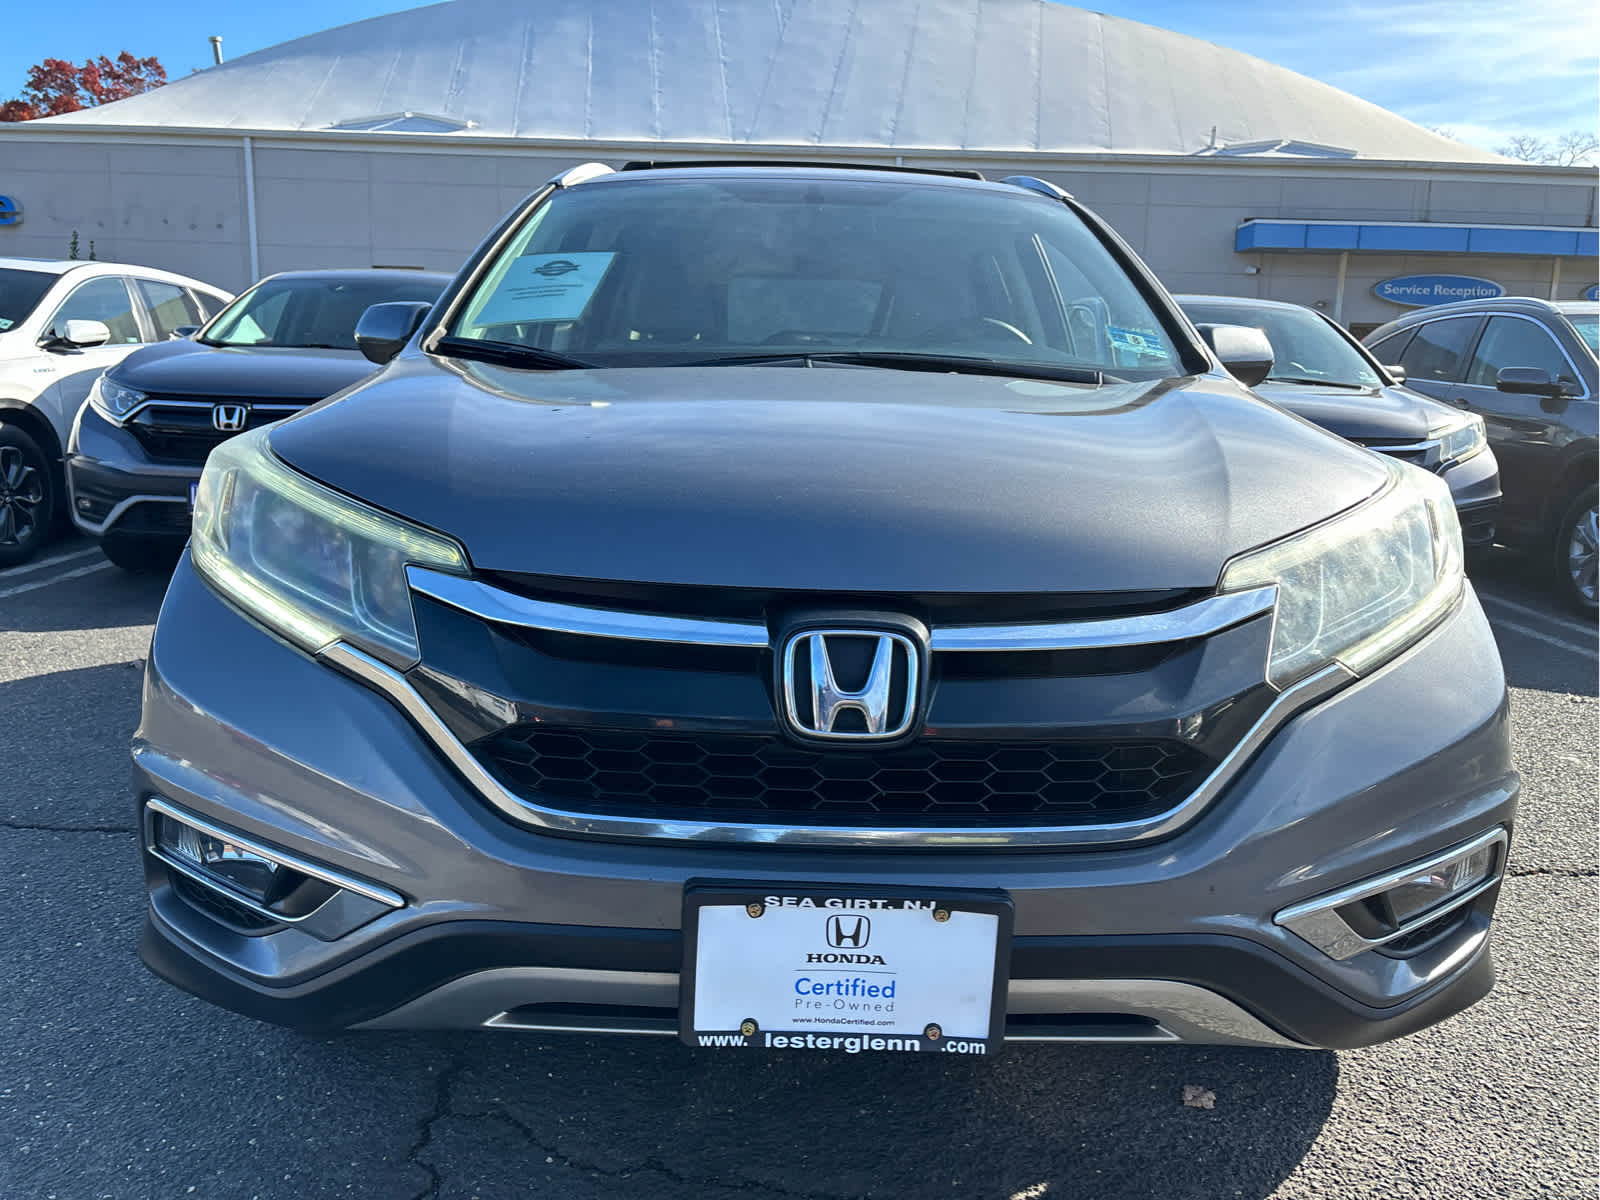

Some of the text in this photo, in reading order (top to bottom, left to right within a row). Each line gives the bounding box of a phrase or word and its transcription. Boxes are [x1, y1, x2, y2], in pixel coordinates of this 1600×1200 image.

[1383, 284, 1497, 298] Service Reception
[763, 896, 817, 909] SEA
[903, 900, 937, 912] NJ
[806, 953, 887, 965] HONDA
[794, 977, 896, 998] Certified
[794, 998, 895, 1012] Pre-Owned
[791, 1017, 896, 1026] www.HondaCertified.com
[698, 1032, 986, 1054] www. lesterglenn .com
